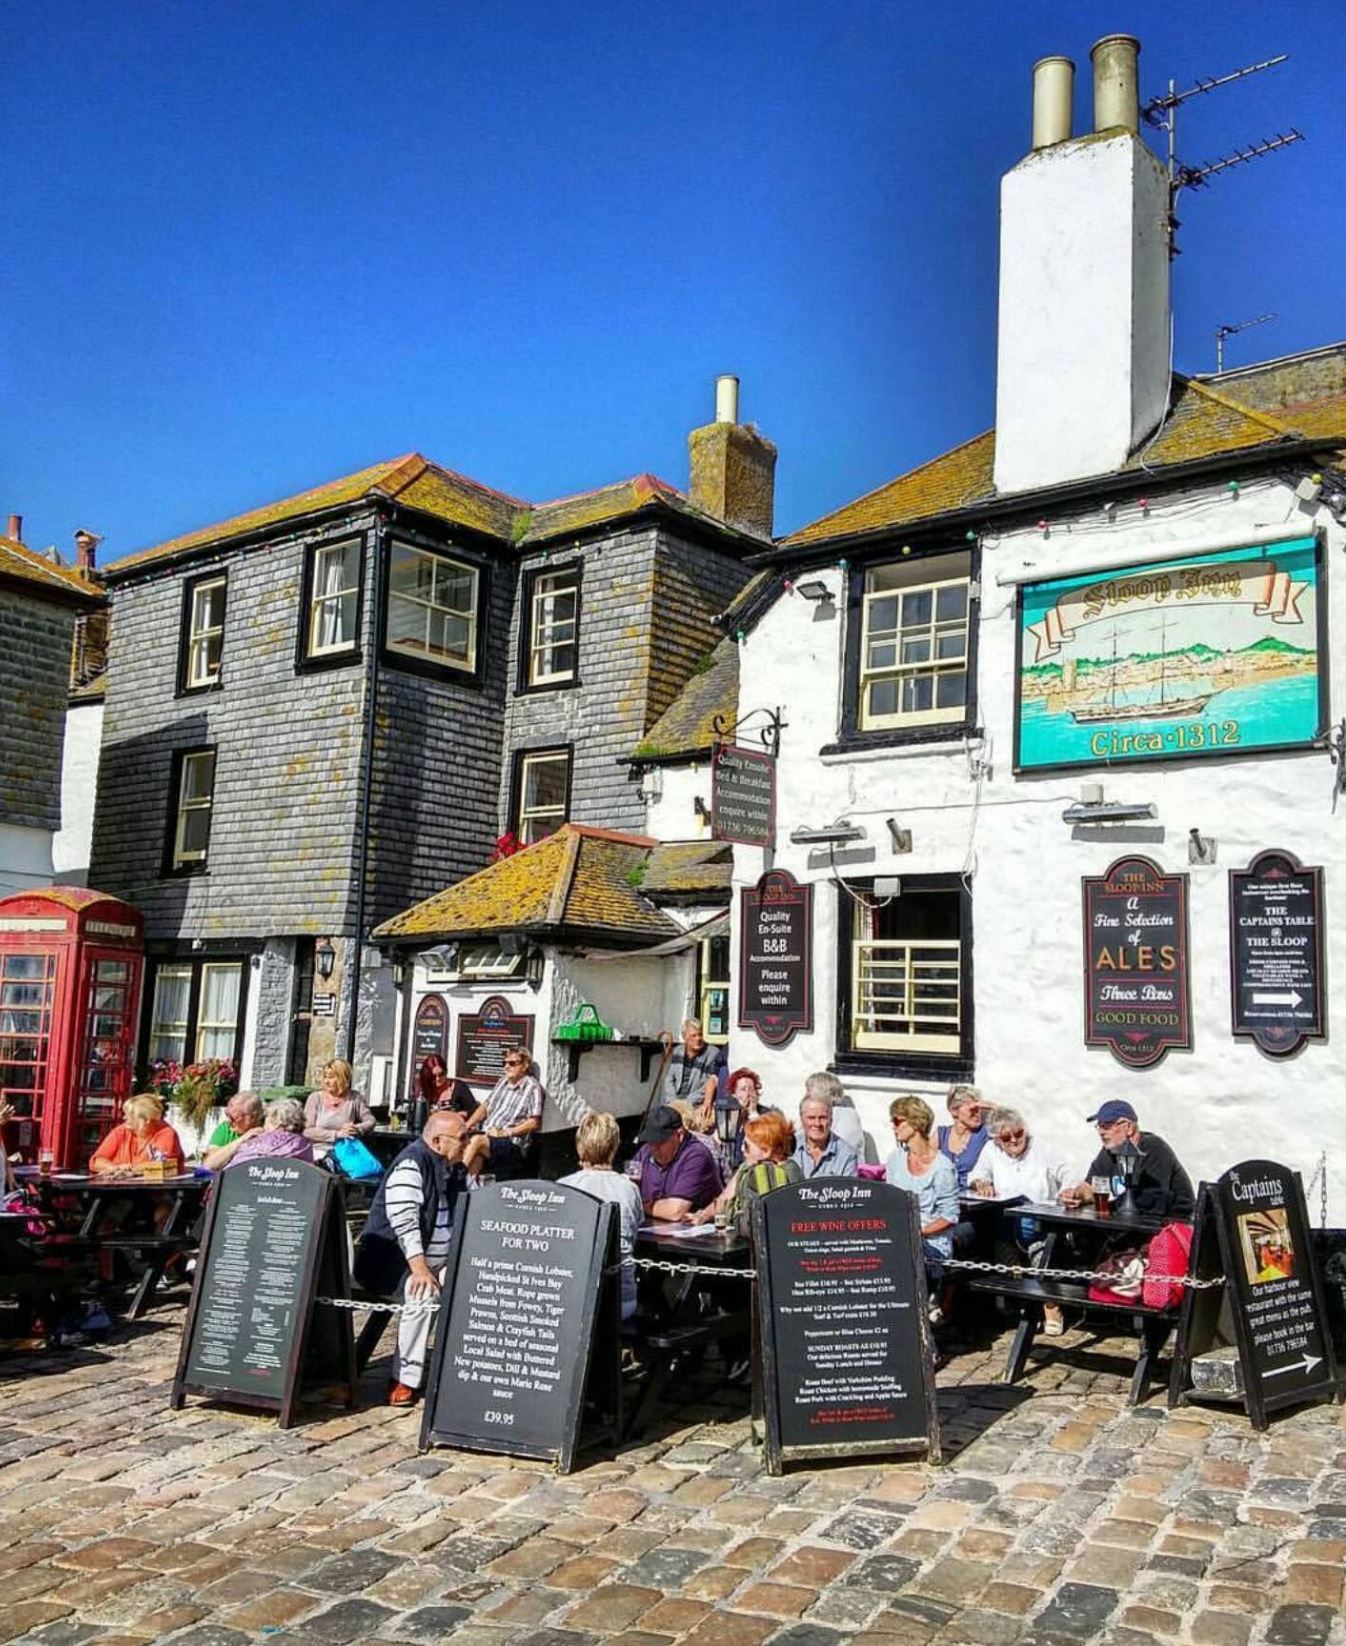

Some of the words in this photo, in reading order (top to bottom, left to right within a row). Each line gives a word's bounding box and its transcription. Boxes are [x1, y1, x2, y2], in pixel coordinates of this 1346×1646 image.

[1082, 575, 1171, 619] Sloop
[1176, 568, 1242, 598] Inn
[718, 754, 742, 769] Quality
[716, 770, 729, 782] Bed
[740, 775, 771, 789] Breakfast
[717, 786, 771, 805] Accommodation
[720, 806, 746, 817] enquire
[748, 809, 768, 820] within
[761, 911, 790, 923] Quality
[1264, 907, 1288, 915] THE
[1094, 914, 1120, 927] Fine
[1124, 913, 1174, 927] Selection
[1240, 917, 1283, 926] CAPTAINS
[1285, 917, 1315, 925] TABLE
[759, 924, 792, 934] En-Suite
[1271, 927, 1282, 937] @
[1128, 929, 1141, 946] of
[1246, 938, 1269, 947] THE
[1271, 937, 1308, 946] SLOOP
[763, 939, 787, 953] B&B
[750, 954, 800, 963] Accommodation
[1096, 945, 1176, 970] ALES
[762, 969, 788, 980] Please
[759, 983, 790, 993] enquire
[1100, 985, 1139, 1000] Three
[761, 995, 787, 1005] within
[1096, 1012, 1136, 1024] GOOD
[1140, 1013, 1179, 1025] FOOD
[248, 1166, 262, 1177] The
[285, 1168, 300, 1179] Inn
[501, 1187, 518, 1199] The
[517, 1189, 547, 1204] Sloop
[547, 1191, 566, 1203] Inn
[799, 1188, 819, 1200] The
[819, 1187, 851, 1203] Sloop
[852, 1186, 872, 1198] Inn
[1232, 1176, 1282, 1204] Captains
[480, 1220, 528, 1234] SEAFOOD
[530, 1225, 575, 1239] PLATTER
[791, 1222, 816, 1233] FREE
[819, 1221, 845, 1231] WINE
[848, 1220, 886, 1231] OFFERS
[502, 1237, 521, 1248] FOR
[523, 1239, 549, 1251] TWO
[471, 1257, 487, 1267] Half
[488, 1260, 492, 1268] a
[493, 1261, 514, 1271] prime
[516, 1262, 544, 1273] Cornish
[479, 1271, 520, 1284] Handpicked
[531, 1277, 546, 1287] Ives
[547, 1278, 562, 1290] Bay
[1252, 1286, 1263, 1296] Our
[1264, 1282, 1286, 1293] harbour
[1288, 1280, 1299, 1288] view
[477, 1283, 494, 1293] Crab
[517, 1288, 536, 1299] Rope
[537, 1292, 560, 1301] grown
[469, 1294, 497, 1306] Mussels
[500, 1298, 517, 1308] from
[546, 1304, 565, 1316] Tiger
[1245, 1299, 1274, 1312] restaurant
[1275, 1295, 1287, 1305] with
[1287, 1292, 1296, 1302] the
[1298, 1290, 1312, 1300] same
[500, 1310, 528, 1322] Scottish
[530, 1315, 559, 1327] Smoked
[1250, 1315, 1264, 1329] great
[1266, 1312, 1281, 1322] menu
[1283, 1311, 1289, 1319] as
[1289, 1307, 1299, 1317] the
[468, 1320, 496, 1331] Salmon
[496, 1323, 503, 1333] &
[505, 1325, 536, 1337] Crayfish
[538, 1329, 555, 1339] Tails
[1254, 1332, 1272, 1346] please
[1273, 1326, 1287, 1339] book
[1289, 1326, 1294, 1335] in
[1295, 1324, 1304, 1333] the
[1305, 1322, 1314, 1331] bar
[463, 1334, 486, 1344] served
[504, 1337, 518, 1347] bed
[519, 1340, 528, 1348] of
[463, 1344, 484, 1356] Local
[485, 1347, 505, 1358] Salad
[506, 1351, 522, 1361] with
[524, 1352, 555, 1366] Buttered
[455, 1356, 471, 1366] New
[505, 1363, 520, 1374] Dill
[521, 1365, 528, 1375] &
[530, 1367, 560, 1380] Mustard
[458, 1370, 470, 1381] dip
[471, 1371, 478, 1381] &
[480, 1374, 492, 1383] our
[493, 1376, 510, 1385] own
[511, 1377, 533, 1389] Marie
[533, 1381, 552, 1392] Rose
[493, 1390, 513, 1399] sauce
[485, 1410, 514, 1425] £39.95
